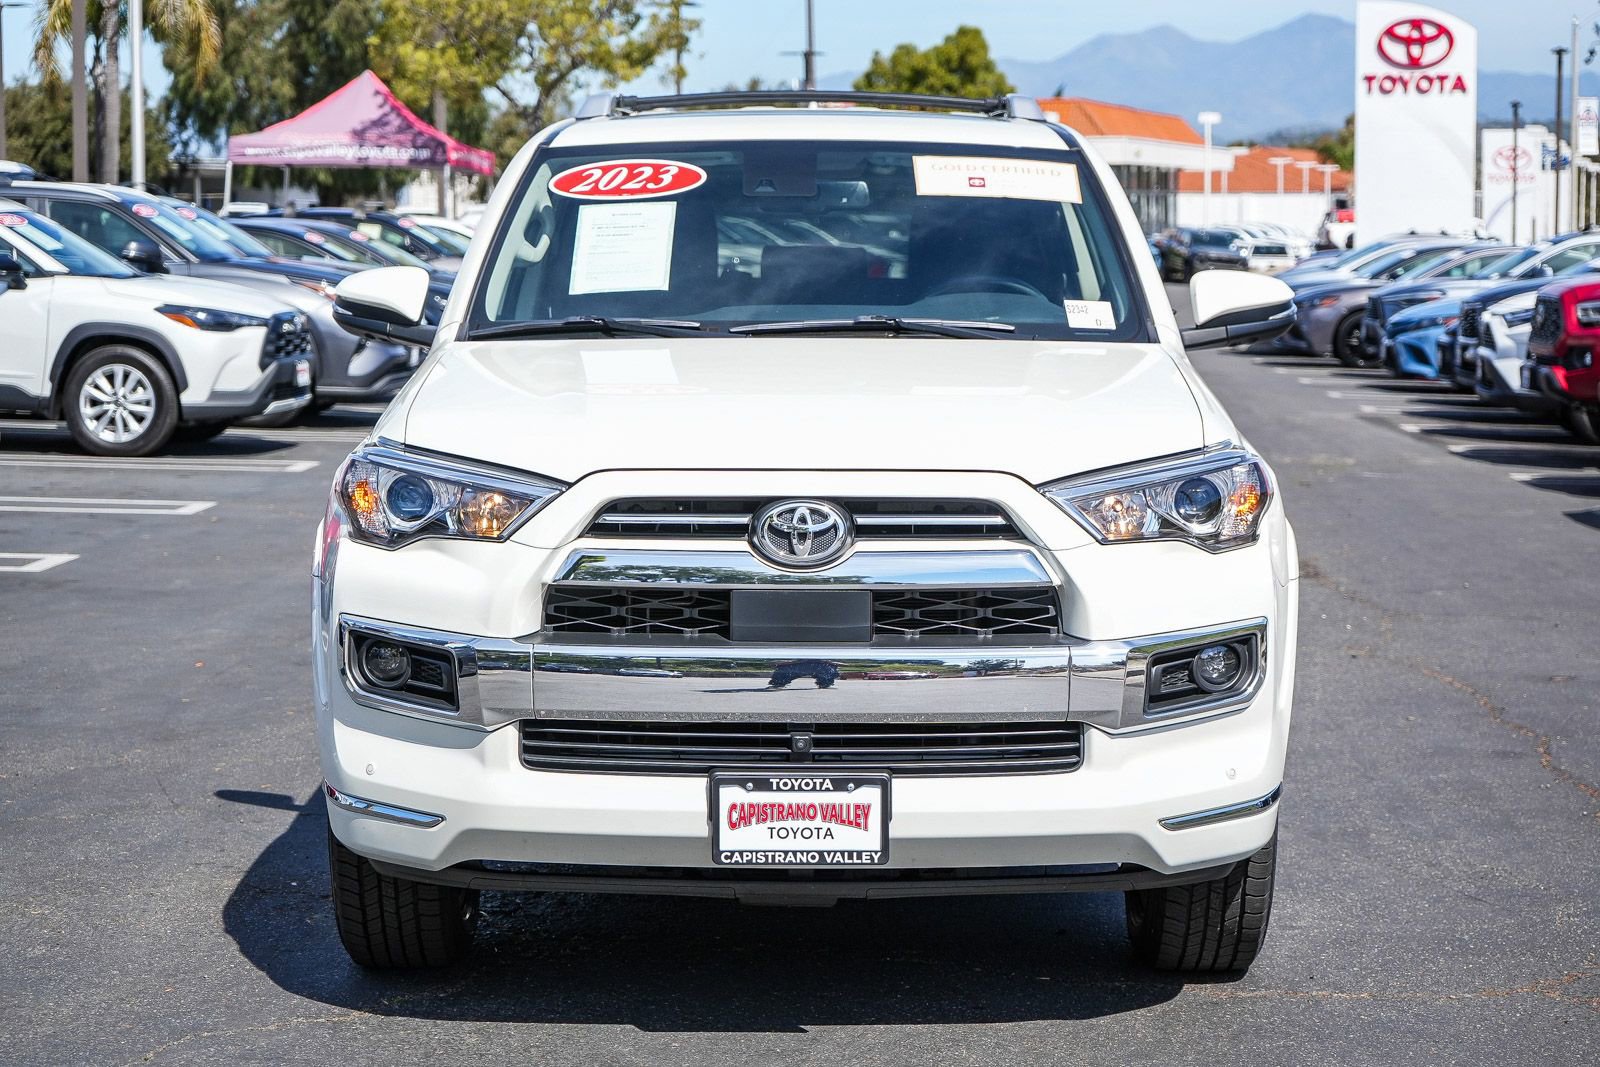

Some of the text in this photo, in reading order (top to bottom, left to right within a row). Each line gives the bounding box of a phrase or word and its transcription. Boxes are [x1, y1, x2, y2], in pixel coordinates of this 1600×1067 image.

[1363, 75, 1466, 95] TOYOTA
[931, 163, 978, 173] GOLD
[569, 165, 680, 193] 2023
[769, 778, 834, 791] TOYOTA
[727, 801, 873, 832] CAPISTRANO VALLEY
[767, 826, 835, 840] TOYOTA
[720, 852, 882, 864] CAPISTRANO VALLEY
